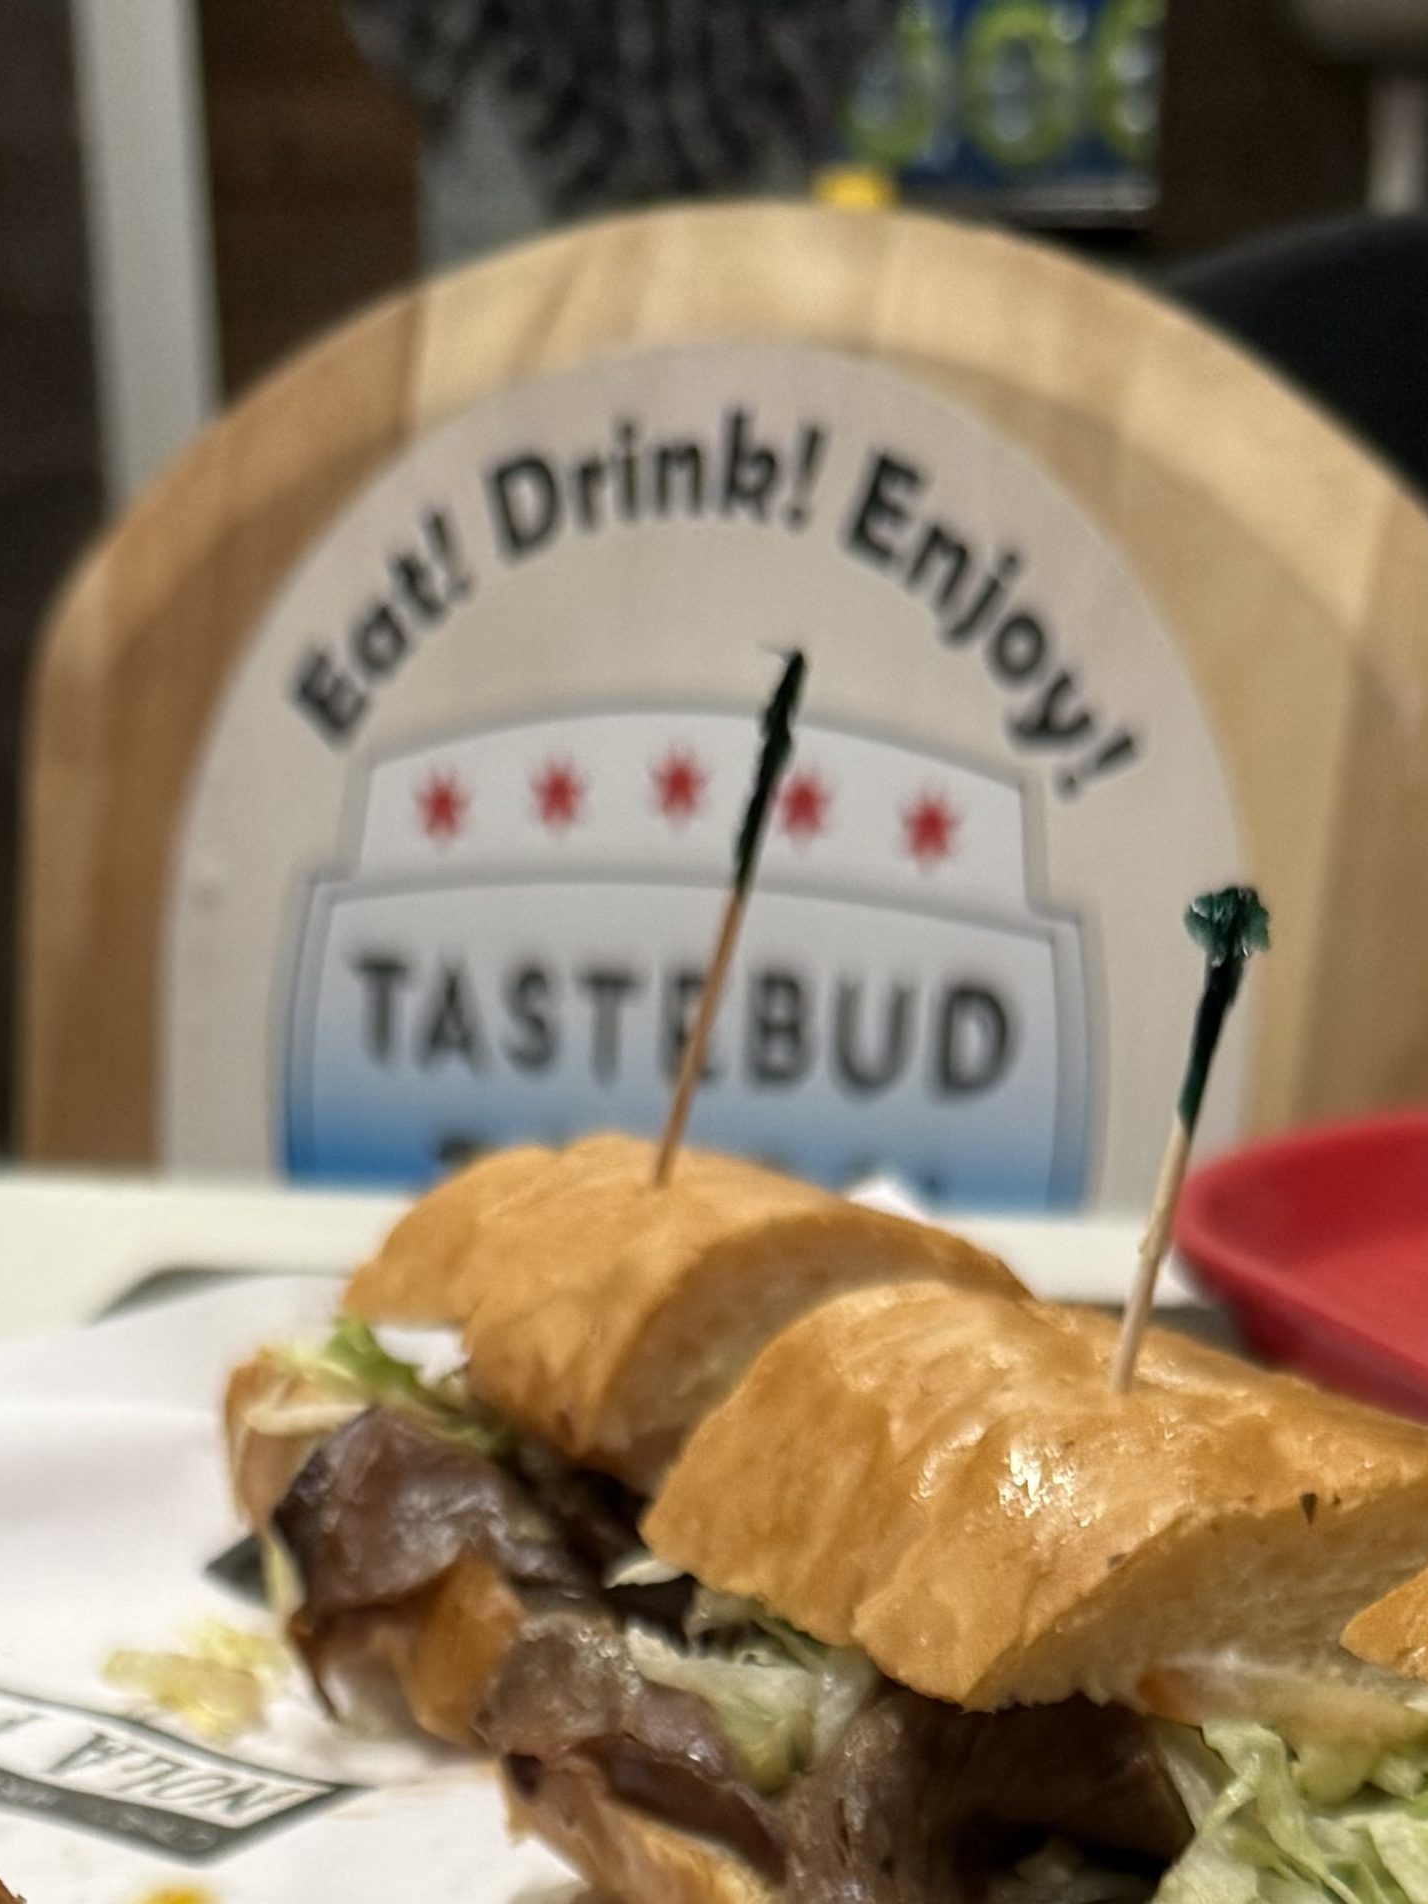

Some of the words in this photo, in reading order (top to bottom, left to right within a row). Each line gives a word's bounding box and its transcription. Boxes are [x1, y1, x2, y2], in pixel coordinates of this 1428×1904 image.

[282, 512, 477, 752] Eat!
[480, 408, 830, 568] Drink!
[835, 448, 1146, 802] Enjoy!
[350, 948, 1014, 1098] TASTEBUD
